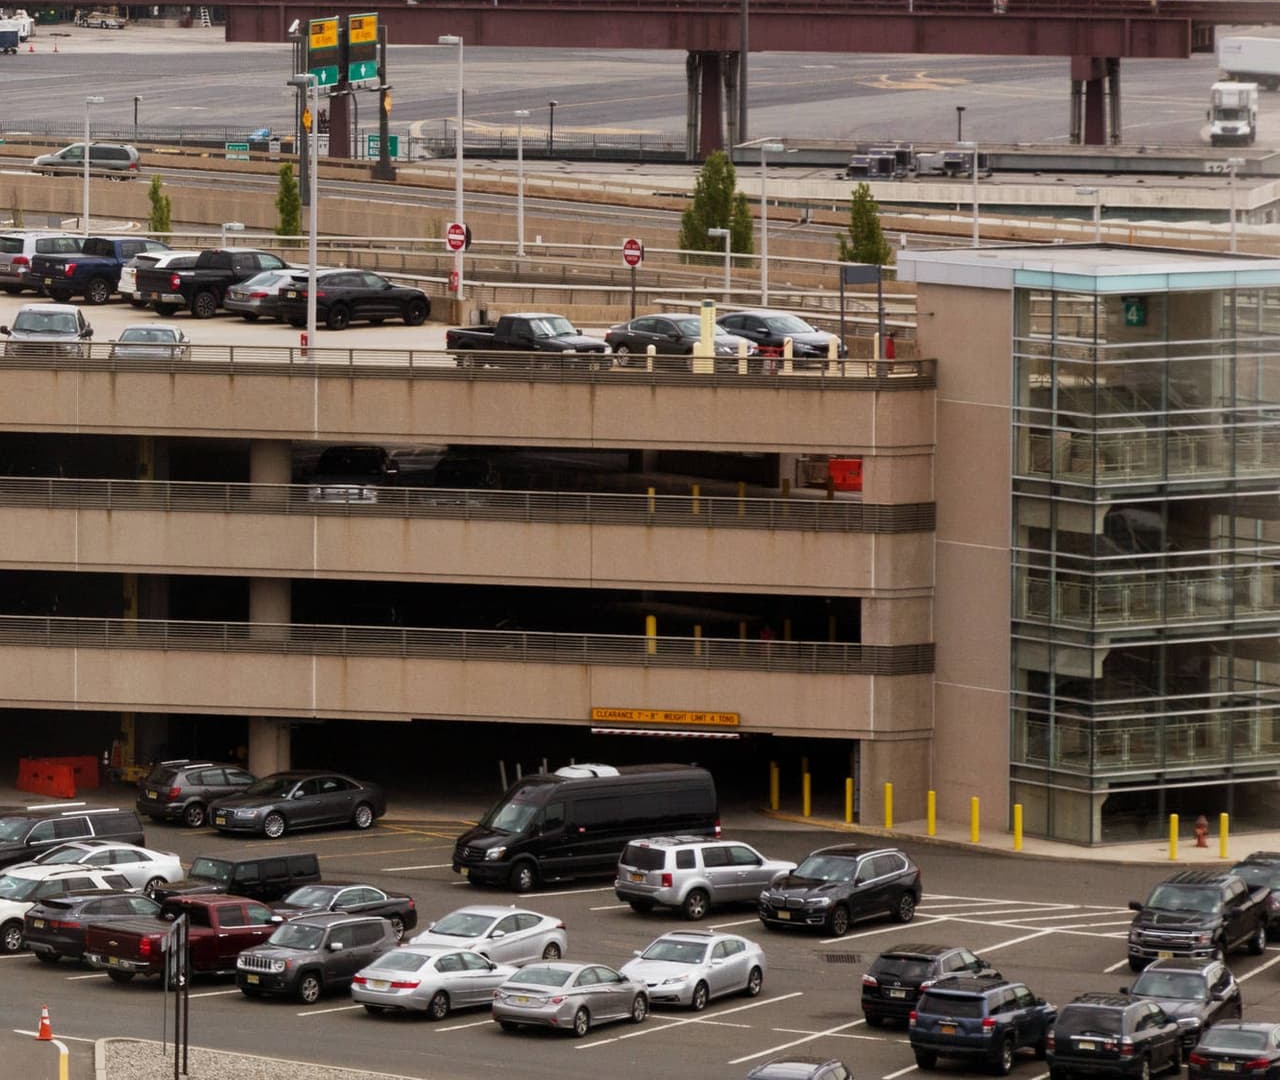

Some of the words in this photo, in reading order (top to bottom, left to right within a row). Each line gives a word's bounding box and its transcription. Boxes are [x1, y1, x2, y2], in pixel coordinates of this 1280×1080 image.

[1127, 305, 1138, 324] 4
[596, 710, 633, 719] CLEARANCE
[664, 713, 687, 721] WEIGHT
